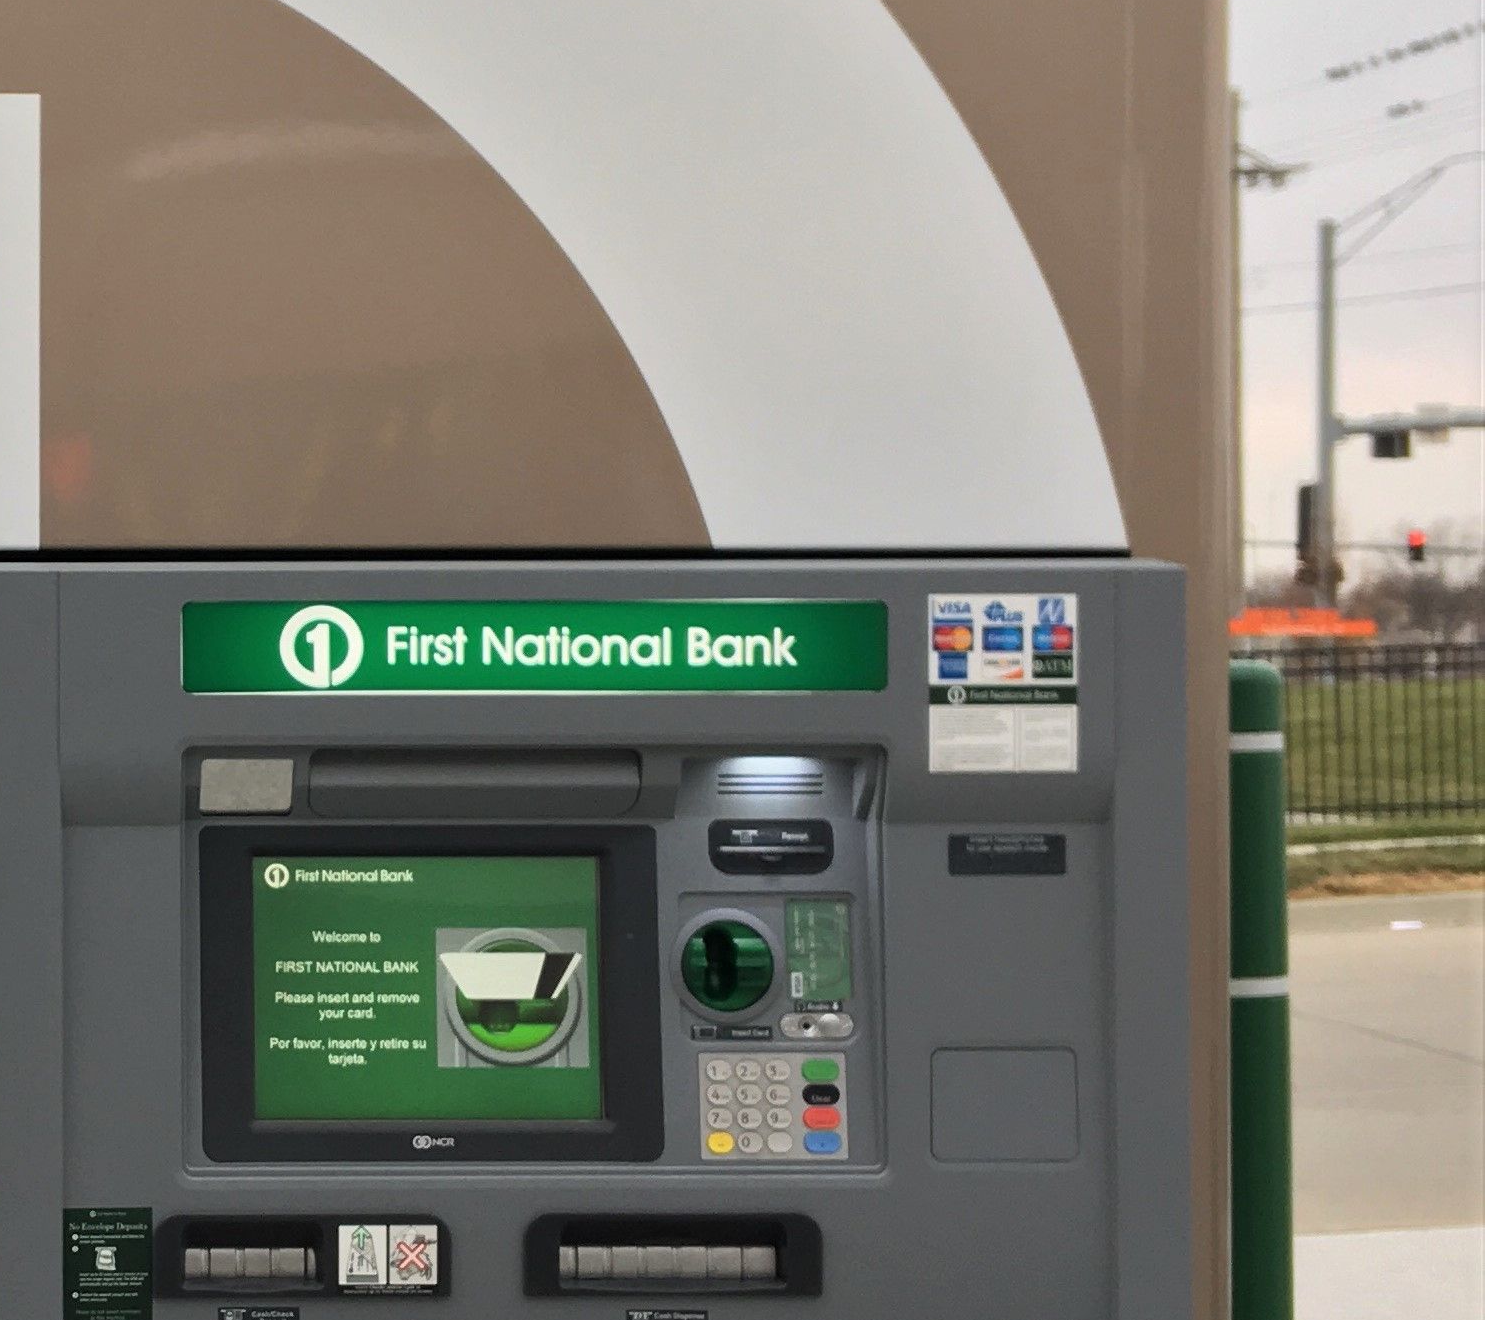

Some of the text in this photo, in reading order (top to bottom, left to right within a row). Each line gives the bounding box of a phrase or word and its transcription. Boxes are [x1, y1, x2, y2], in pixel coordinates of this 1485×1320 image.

[386, 625, 468, 667] First
[481, 625, 672, 667] National
[686, 626, 799, 668] Bank
[295, 869, 320, 883] First
[321, 869, 378, 883] National
[380, 869, 414, 883] Bank
[312, 931, 381, 944] Welcome to
[275, 960, 419, 974] FIRST NATIONAL BANK
[274, 991, 420, 1004] Please insert and remove
[318, 1007, 376, 1021] your card.
[269, 1037, 427, 1052] Por favor, inserte y retire su
[328, 1053, 367, 1067] tarjeta.
[432, 1137, 455, 1147] NCR
